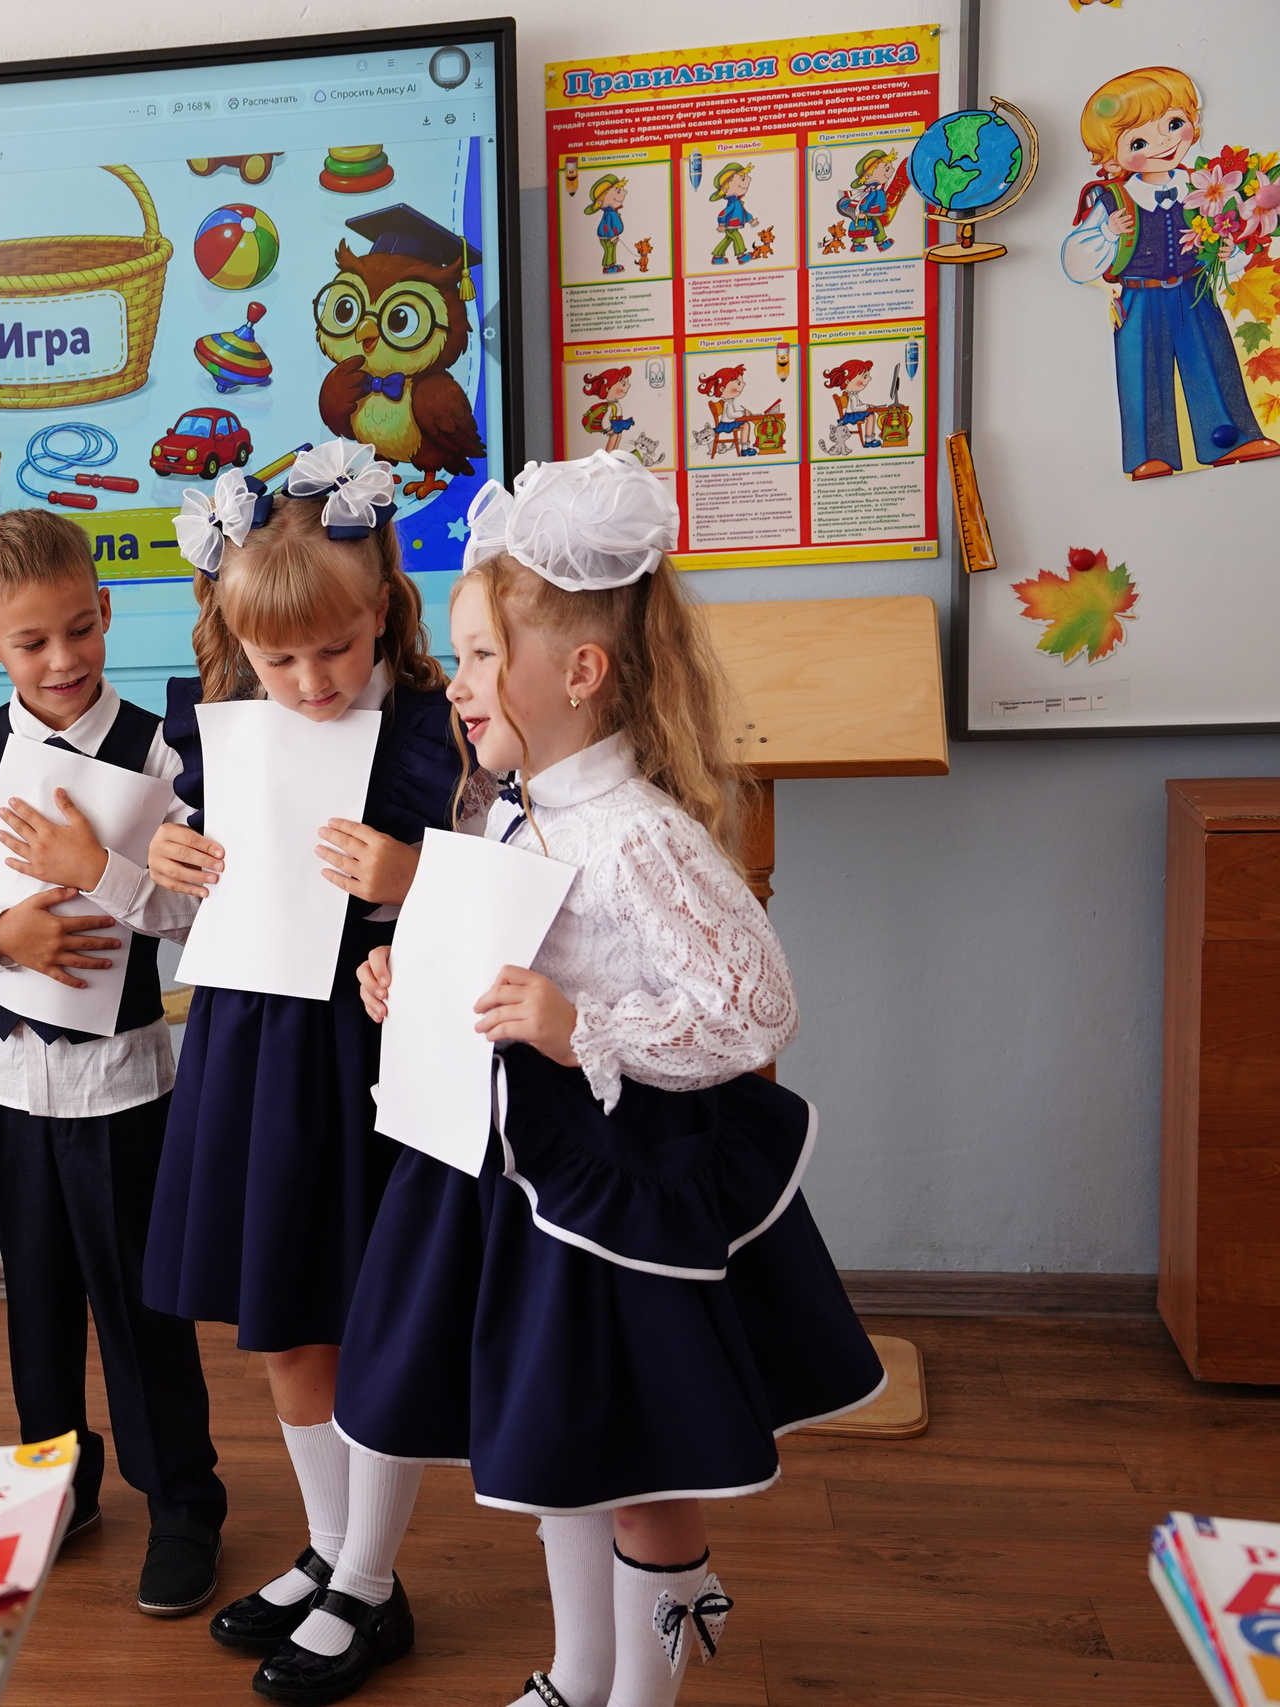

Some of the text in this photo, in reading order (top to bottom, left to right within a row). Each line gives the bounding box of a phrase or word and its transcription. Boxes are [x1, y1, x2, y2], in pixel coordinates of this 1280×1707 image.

[564, 41, 920, 98] Правильная осанка
[242, 95, 298, 107] Распечатать
[330, 88, 374, 101] Спросить
[376, 86, 406, 97] Алису
[574, 108, 623, 119] Правильная
[695, 98, 738, 108] развивать
[747, 93, 789, 103] укреплять
[791, 86, 870, 99] костно-мышечную
[872, 82, 910, 91] систему,
[553, 121, 585, 131] придаёт
[587, 117, 633, 128] стройность
[642, 114, 674, 123] красоту
[676, 111, 706, 120] фигуре
[716, 104, 771, 116] способствует
[773, 99, 824, 110] правильной
[825, 96, 854, 106] работе
[882, 90, 931, 100] организма.
[594, 127, 628, 136] Человек
[637, 122, 686, 133] правильной
[688, 118, 722, 127] осанкой
[759, 112, 786, 122] устаёт
[827, 104, 889, 115] передвижения
[586, 137, 628, 147] «сидячей»
[630, 134, 662, 143] работы,
[664, 132, 693, 140] потому
[710, 127, 748, 136] нагрузка
[762, 121, 817, 130] позвоночник
[826, 117, 859, 125] мышцы
[861, 111, 920, 122] уменьшается.
[820, 126, 911, 142] При переносе тяжестей
[717, 140, 762, 152] При ходьбе
[588, 153, 630, 162] положении
[868, 327, 922, 335] компьютером
[700, 340, 716, 348] При
[716, 338, 744, 347] работе
[756, 334, 782, 344] партой
[633, 345, 661, 353] рюкзак
